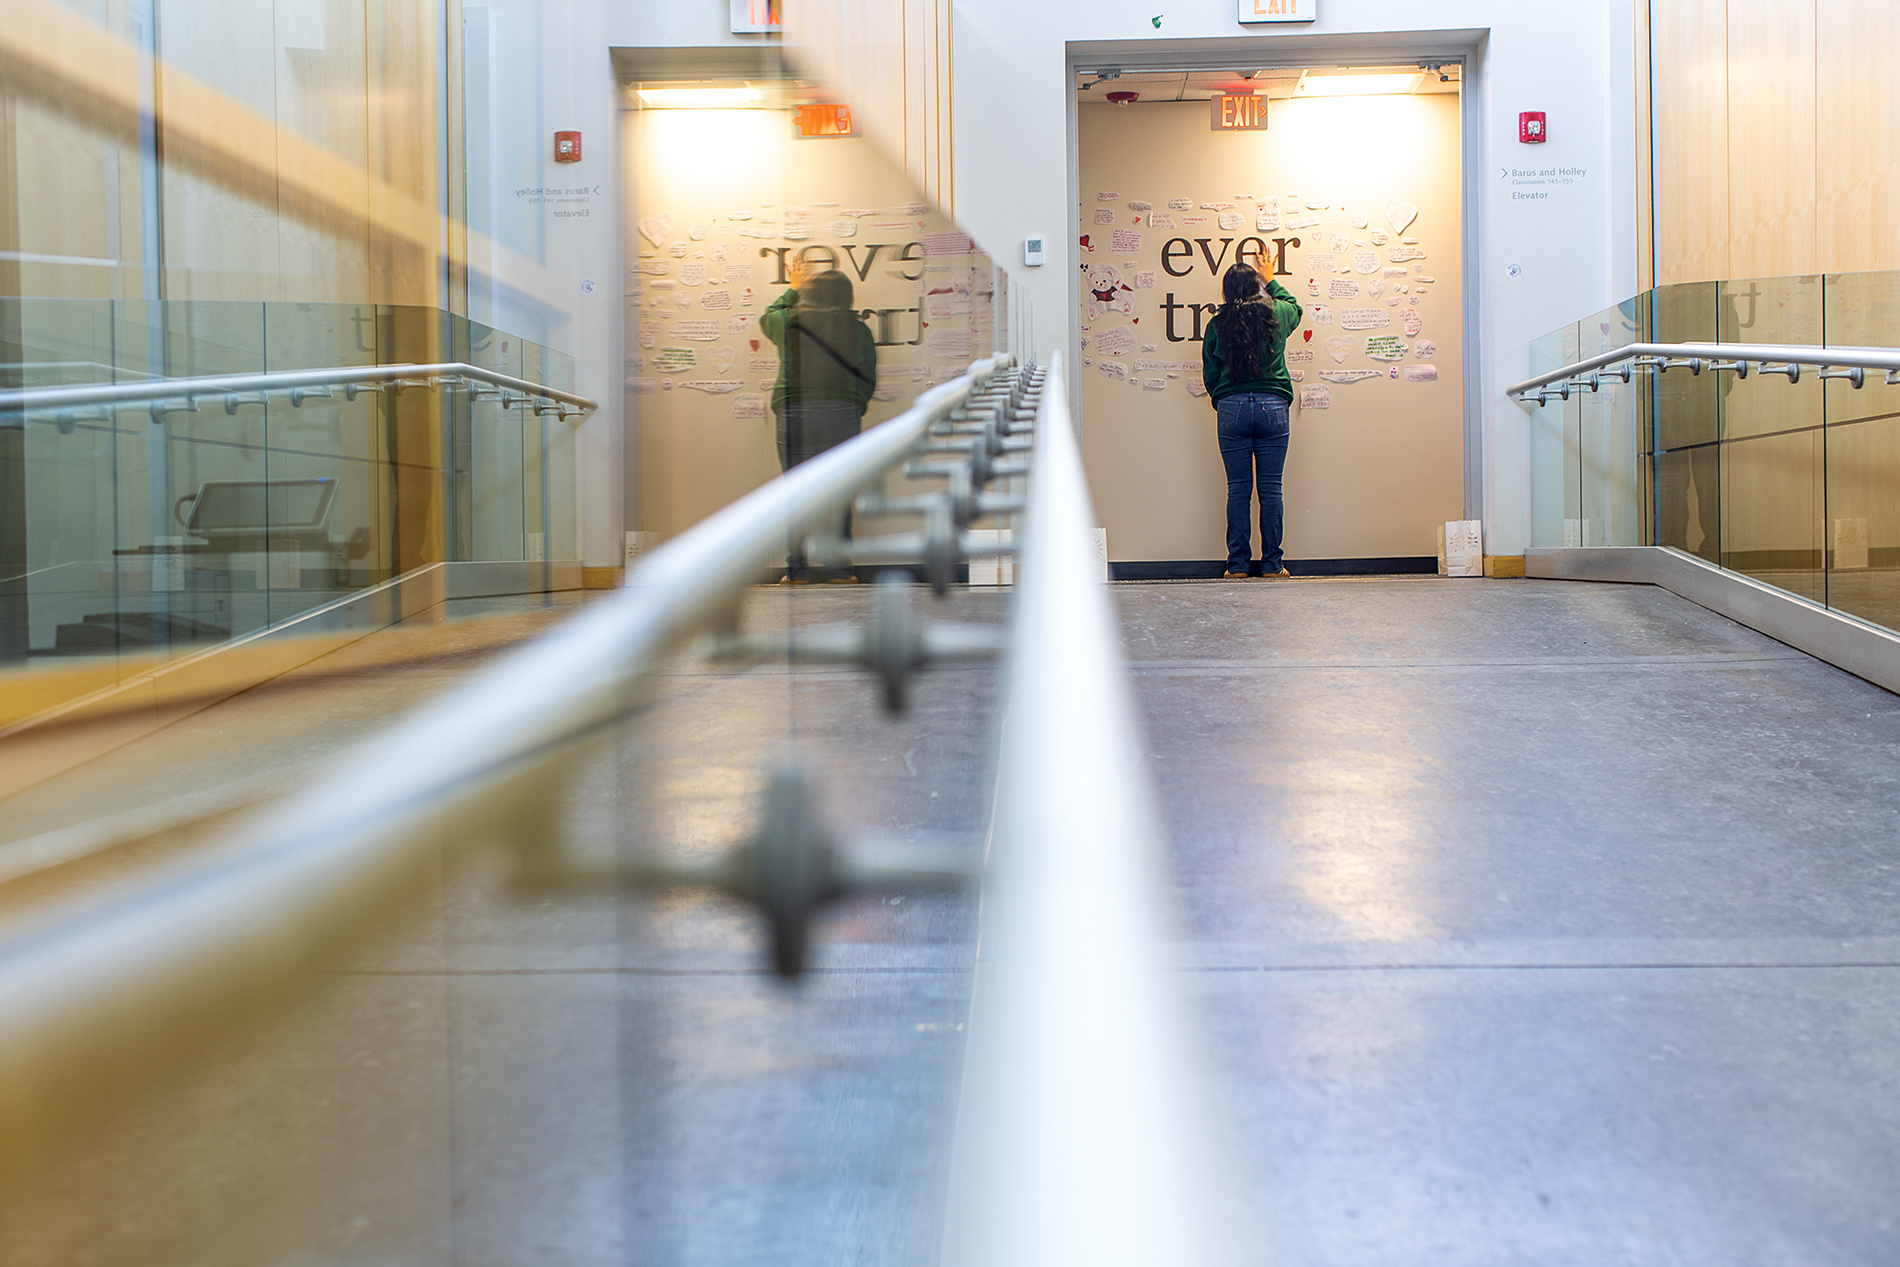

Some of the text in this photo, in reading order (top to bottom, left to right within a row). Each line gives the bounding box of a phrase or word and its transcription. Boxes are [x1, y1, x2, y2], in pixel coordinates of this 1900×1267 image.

[1221, 95, 1262, 127] EXIT
[1511, 166, 1588, 177] Barus and Holley
[1511, 191, 1548, 199] Elevator
[1161, 236, 1301, 278] ever
[1159, 292, 1224, 342] tr
